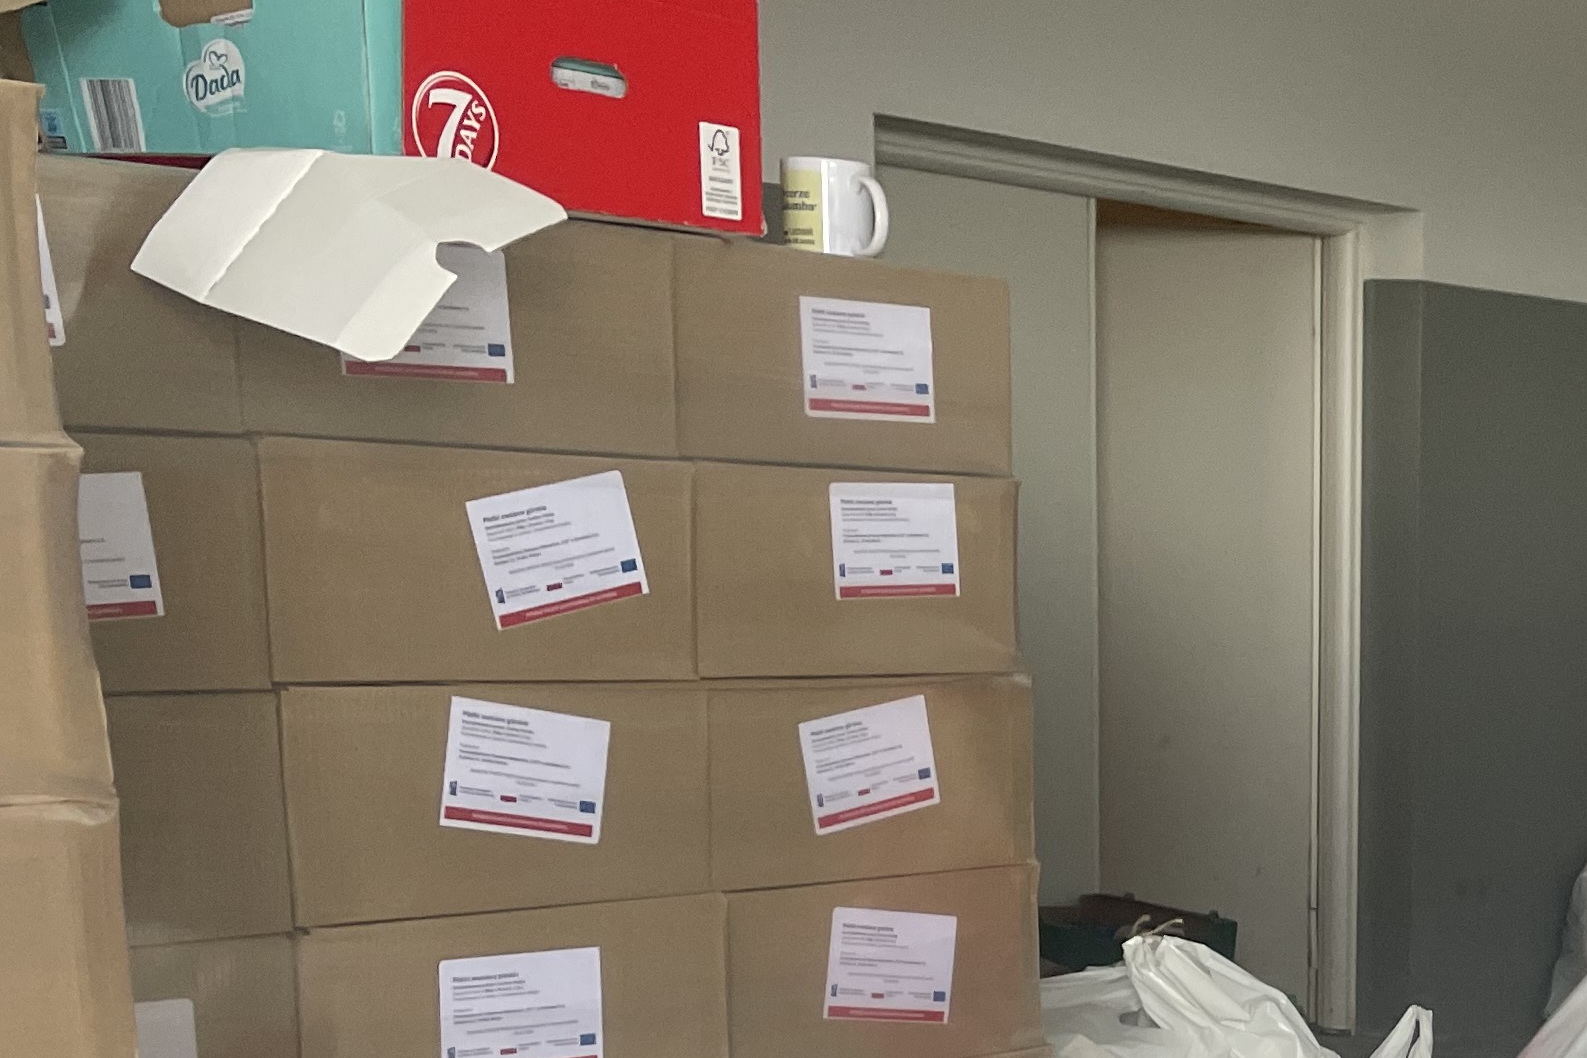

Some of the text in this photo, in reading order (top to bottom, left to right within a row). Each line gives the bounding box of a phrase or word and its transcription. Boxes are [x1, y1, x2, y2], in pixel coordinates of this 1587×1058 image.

[191, 64, 241, 101] Dada
[428, 88, 486, 161] 7 DAYS
